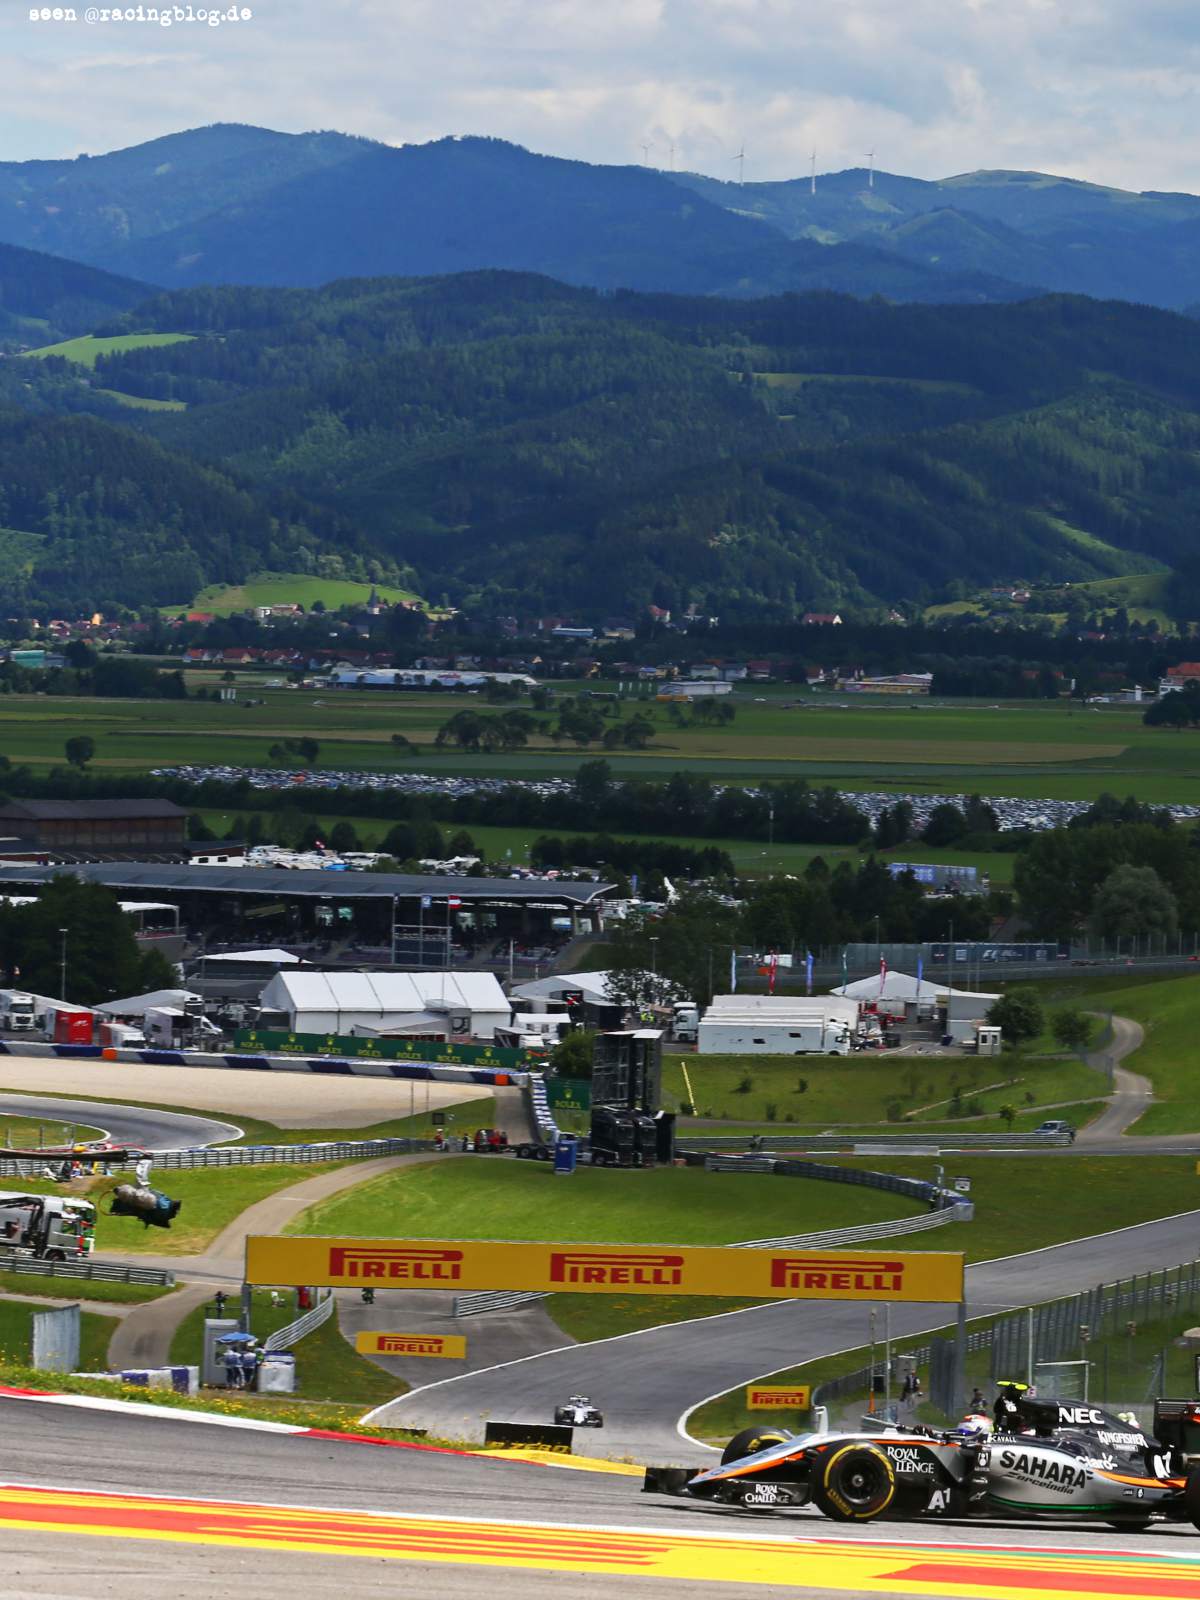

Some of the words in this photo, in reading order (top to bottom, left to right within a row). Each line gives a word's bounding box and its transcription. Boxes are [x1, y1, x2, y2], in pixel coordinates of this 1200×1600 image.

[329, 1247, 464, 1280] PIRELLI
[550, 1252, 684, 1285] PIRELLI
[771, 1258, 904, 1291] PIRELLI
[377, 1336, 444, 1354] PIRELLI
[752, 1392, 804, 1404] PIRELLI
[1058, 1407, 1105, 1424] NEC
[1097, 1430, 1149, 1449] KINGFISHER
[887, 1446, 920, 1462] ROYAL
[895, 1460, 935, 1474] LLENGE
[1000, 1450, 1086, 1488] SAHARA
[928, 1487, 951, 1509] A1
